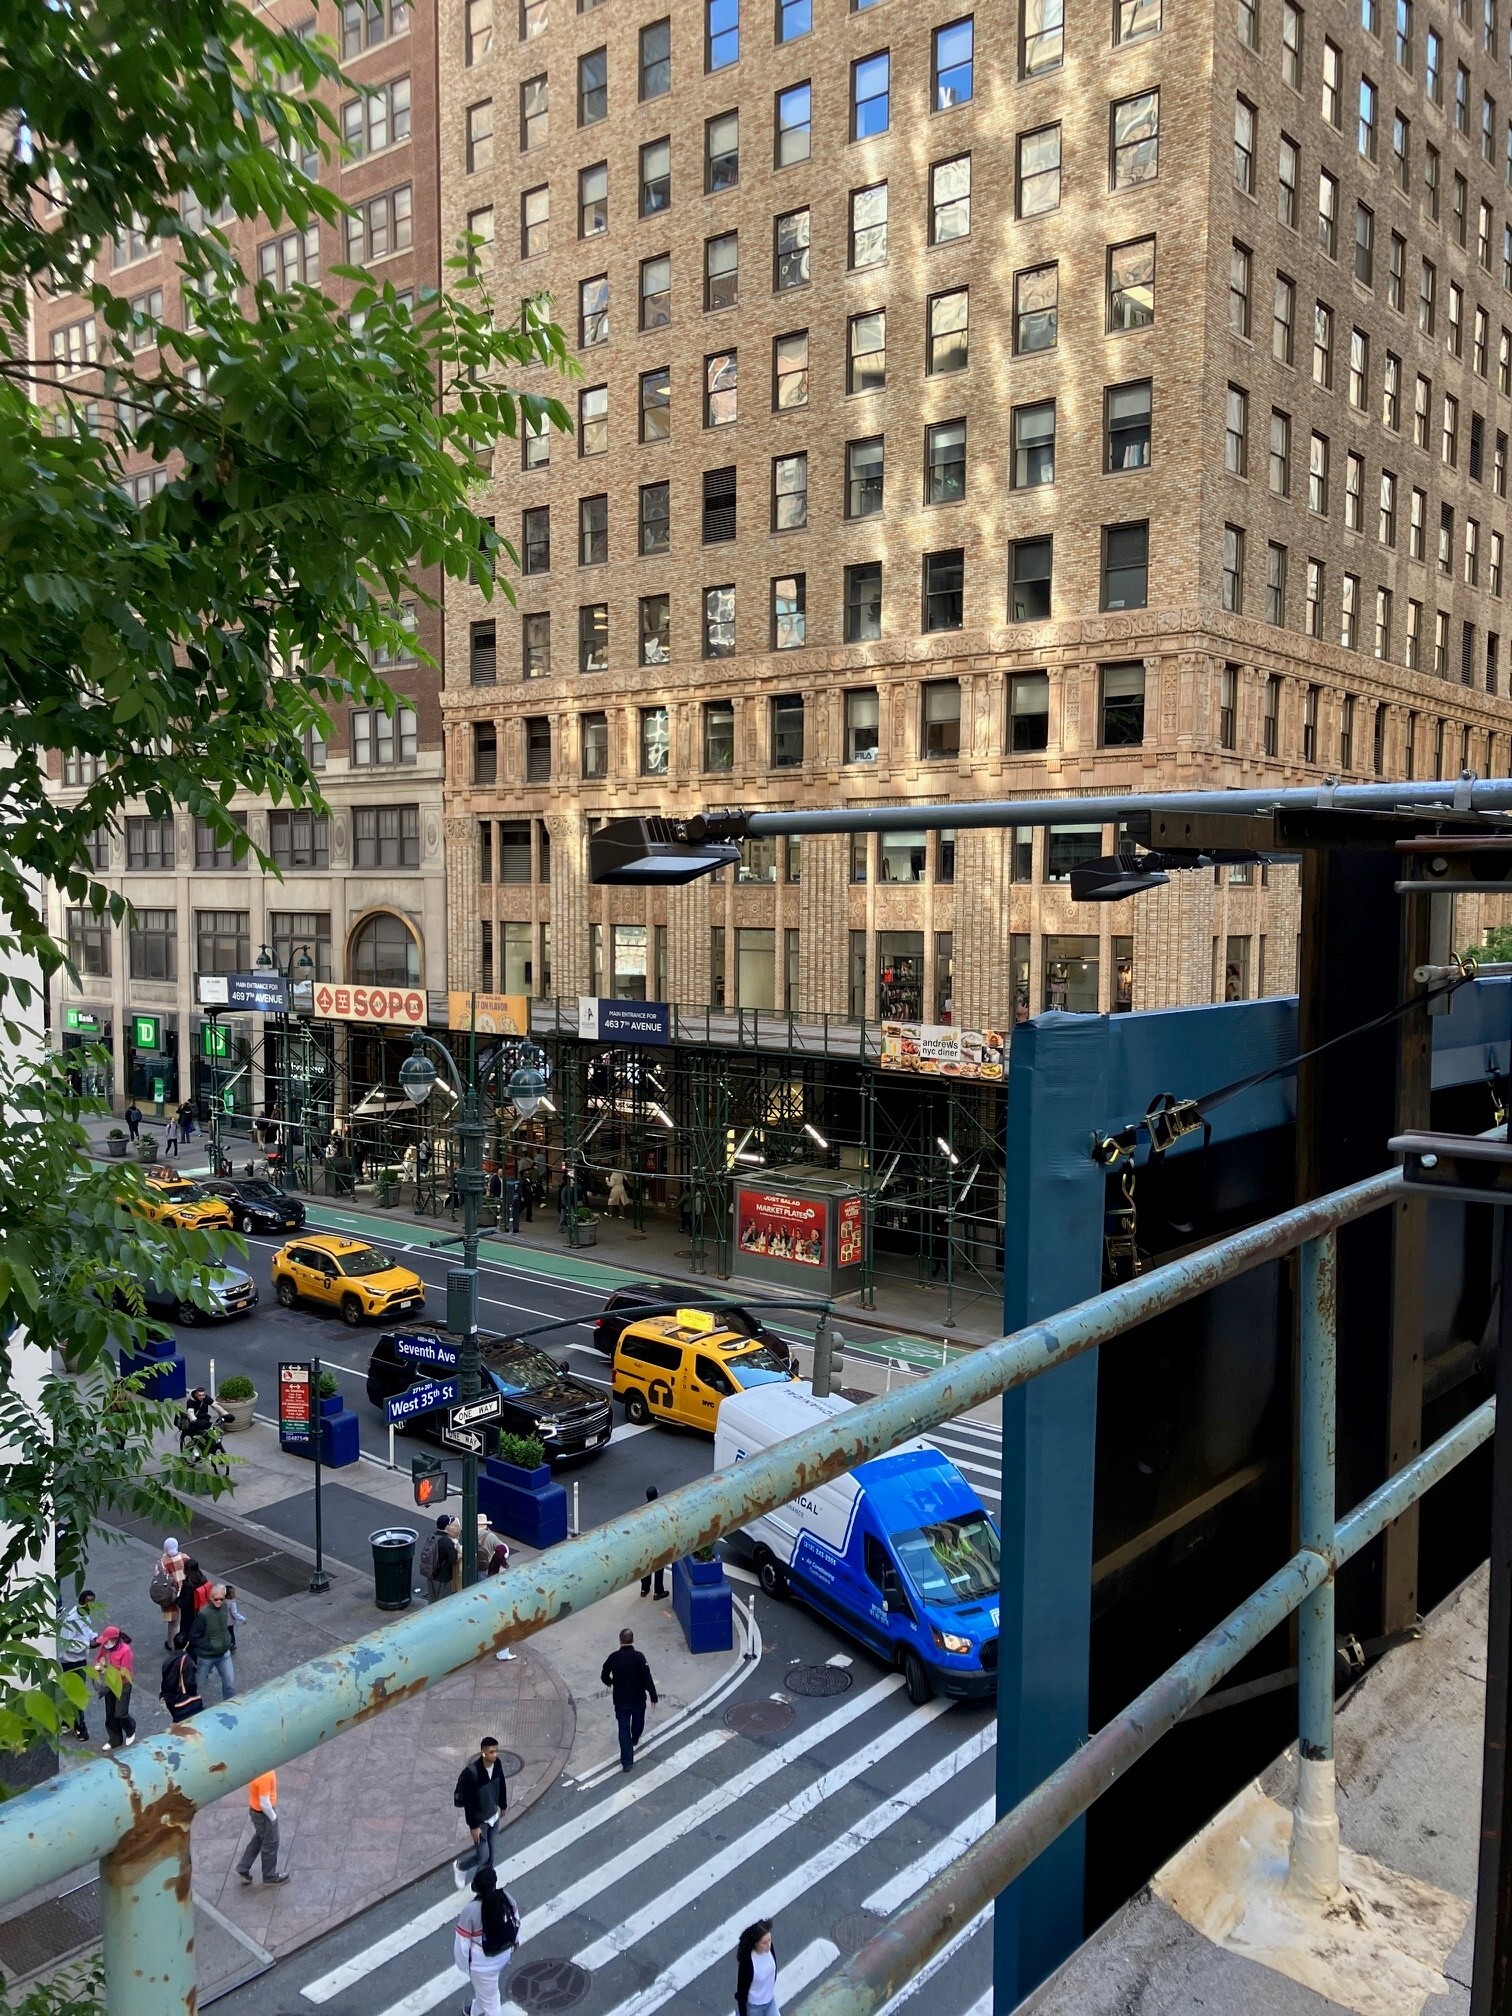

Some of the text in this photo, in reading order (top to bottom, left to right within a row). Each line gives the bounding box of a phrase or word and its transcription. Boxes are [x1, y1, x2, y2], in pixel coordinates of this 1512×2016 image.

[854, 751, 872, 761] FILA
[235, 981, 278, 991] MAIN ENTRANCE FOR
[232, 991, 245, 1001] 469
[255, 993, 283, 1004] AVENUE
[354, 989, 423, 1021] SOPO
[465, 1000, 508, 1012] FEST ON FLAVOR
[78, 1013, 94, 1023] Bank
[621, 1011, 646, 1019] ENTRANCE
[604, 1019, 619, 1029] 463
[630, 1021, 662, 1032] AVENUE
[138, 1023, 154, 1042] TD
[937, 1048, 958, 1057] diner
[763, 1195, 779, 1203] JUST
[780, 1198, 801, 1207] SALAD
[756, 1203, 783, 1215] MARKET
[783, 1208, 808, 1220] PLATES
[398, 1340, 456, 1364] Seventh Ave
[391, 1385, 453, 1417] West 35th St
[702, 1399, 715, 1409] NYC
[458, 1402, 494, 1421] ONE WAY
[448, 1432, 477, 1446] ONE WAY
[811, 1560, 835, 1582] Conditioning
